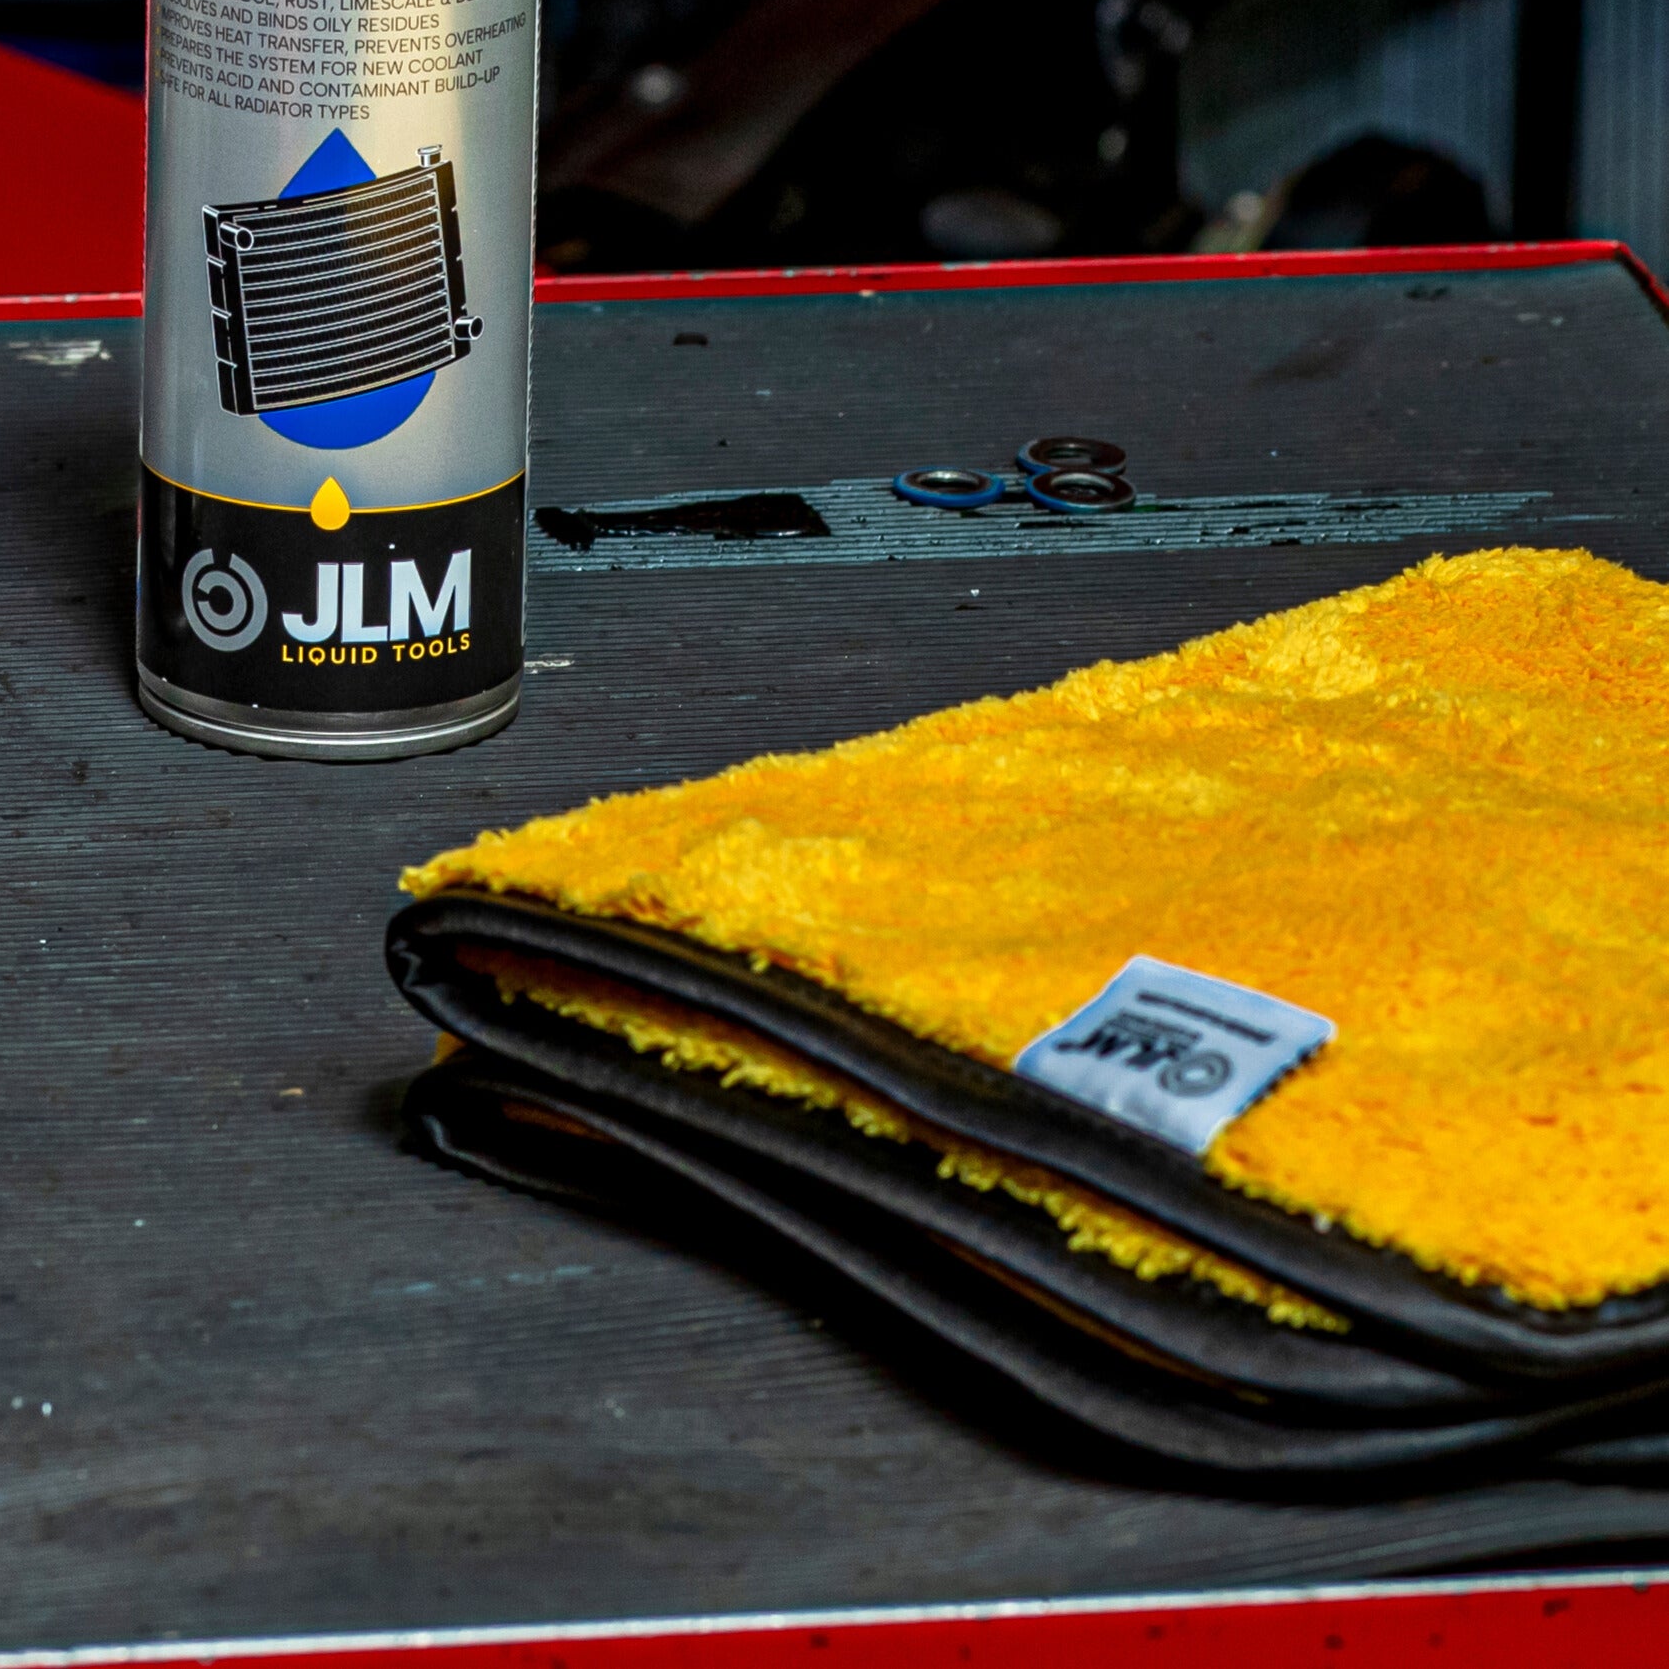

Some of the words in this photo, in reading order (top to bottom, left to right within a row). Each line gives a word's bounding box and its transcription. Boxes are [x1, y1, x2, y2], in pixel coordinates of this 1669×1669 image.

[161, 6, 212, 38] IMPROVES
[215, 26, 253, 46] HEAT
[258, 33, 349, 57] TRANSFER,
[354, 35, 441, 54] PREVENTS
[444, 11, 527, 49] OVERHEATING
[220, 5, 253, 24] AND
[258, 13, 308, 30] BINDS
[313, 17, 352, 32] OILY
[358, 14, 440, 32] RESIDUES
[160, 26, 212, 60] PREPARES
[216, 47, 244, 67] THE
[248, 54, 315, 75] SYSTEM
[321, 61, 357, 76] FOR
[363, 61, 403, 76] NEW
[408, 49, 484, 74] COOLANT
[160, 49, 213, 82] PREVENTS
[216, 70, 254, 89] ACID
[258, 77, 294, 95] AND
[299, 80, 430, 98] CONTAMINANT
[435, 66, 501, 93] BUILD-UP
[183, 81, 205, 101] FOR
[208, 89, 230, 108] ALL
[235, 95, 312, 118] RADIATOR
[318, 104, 370, 119] TYPES
[282, 549, 471, 643] JLM
[282, 645, 377, 665] LIQUID
[392, 634, 470, 662] TOOLS
